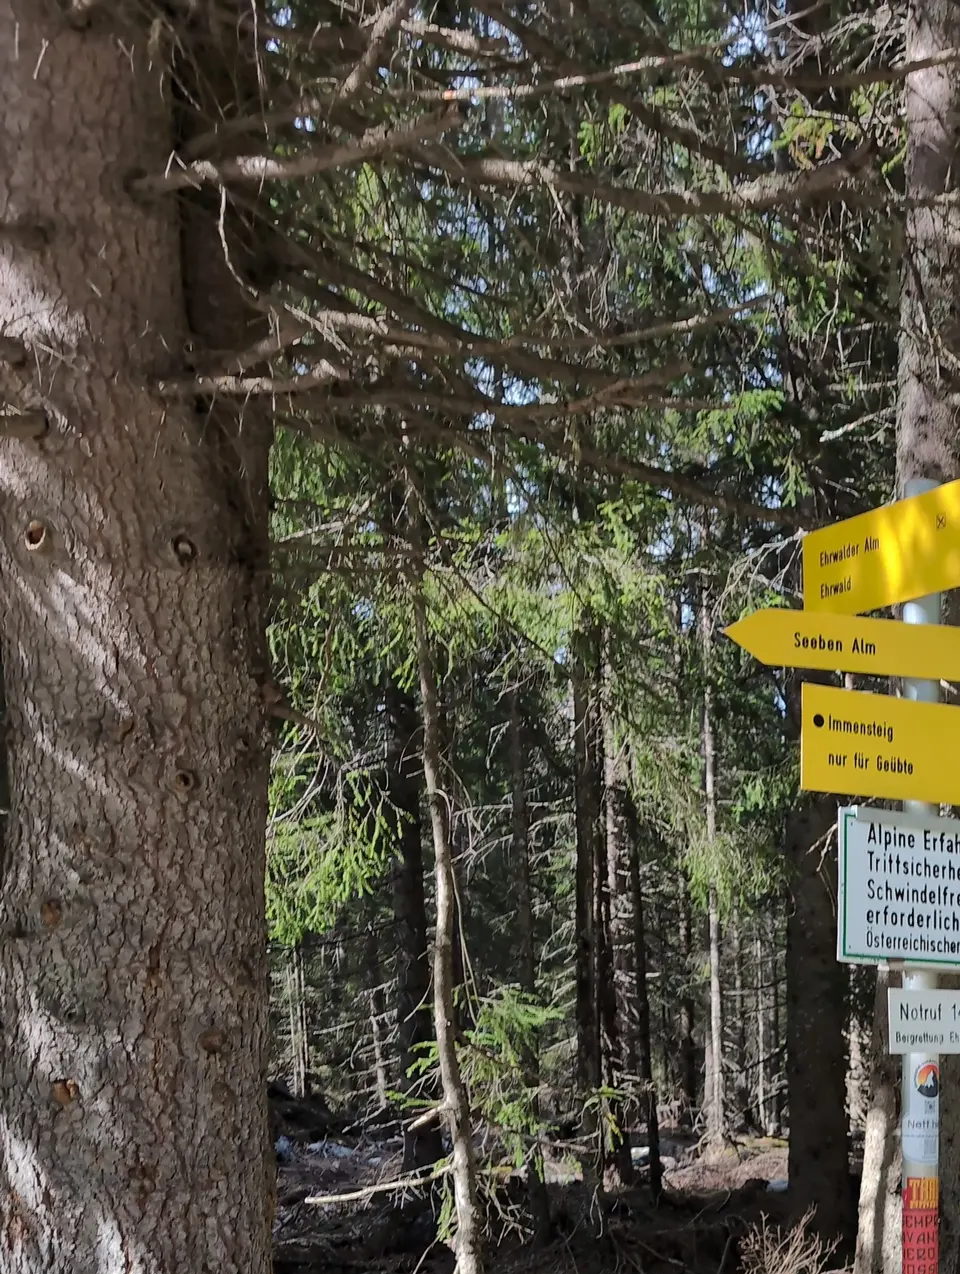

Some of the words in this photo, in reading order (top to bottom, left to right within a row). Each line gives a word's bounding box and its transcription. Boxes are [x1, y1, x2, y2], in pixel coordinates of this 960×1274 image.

[820, 543, 859, 567] Ehrwalder
[864, 536, 880, 554] Alm
[820, 576, 851, 599] Ehrwald
[794, 631, 843, 652] Seeben
[852, 637, 876, 656] Alm
[828, 713, 893, 743] Immensteig
[828, 753, 847, 767] nur
[854, 752, 869, 770] für
[876, 755, 914, 775] Geübte
[867, 822, 915, 851] Alpine
[866, 905, 960, 932] erforderlich
[866, 926, 960, 954] Österreichischer
[900, 1002, 942, 1021] Notruf
[895, 1031, 944, 1045] Bergrettung
